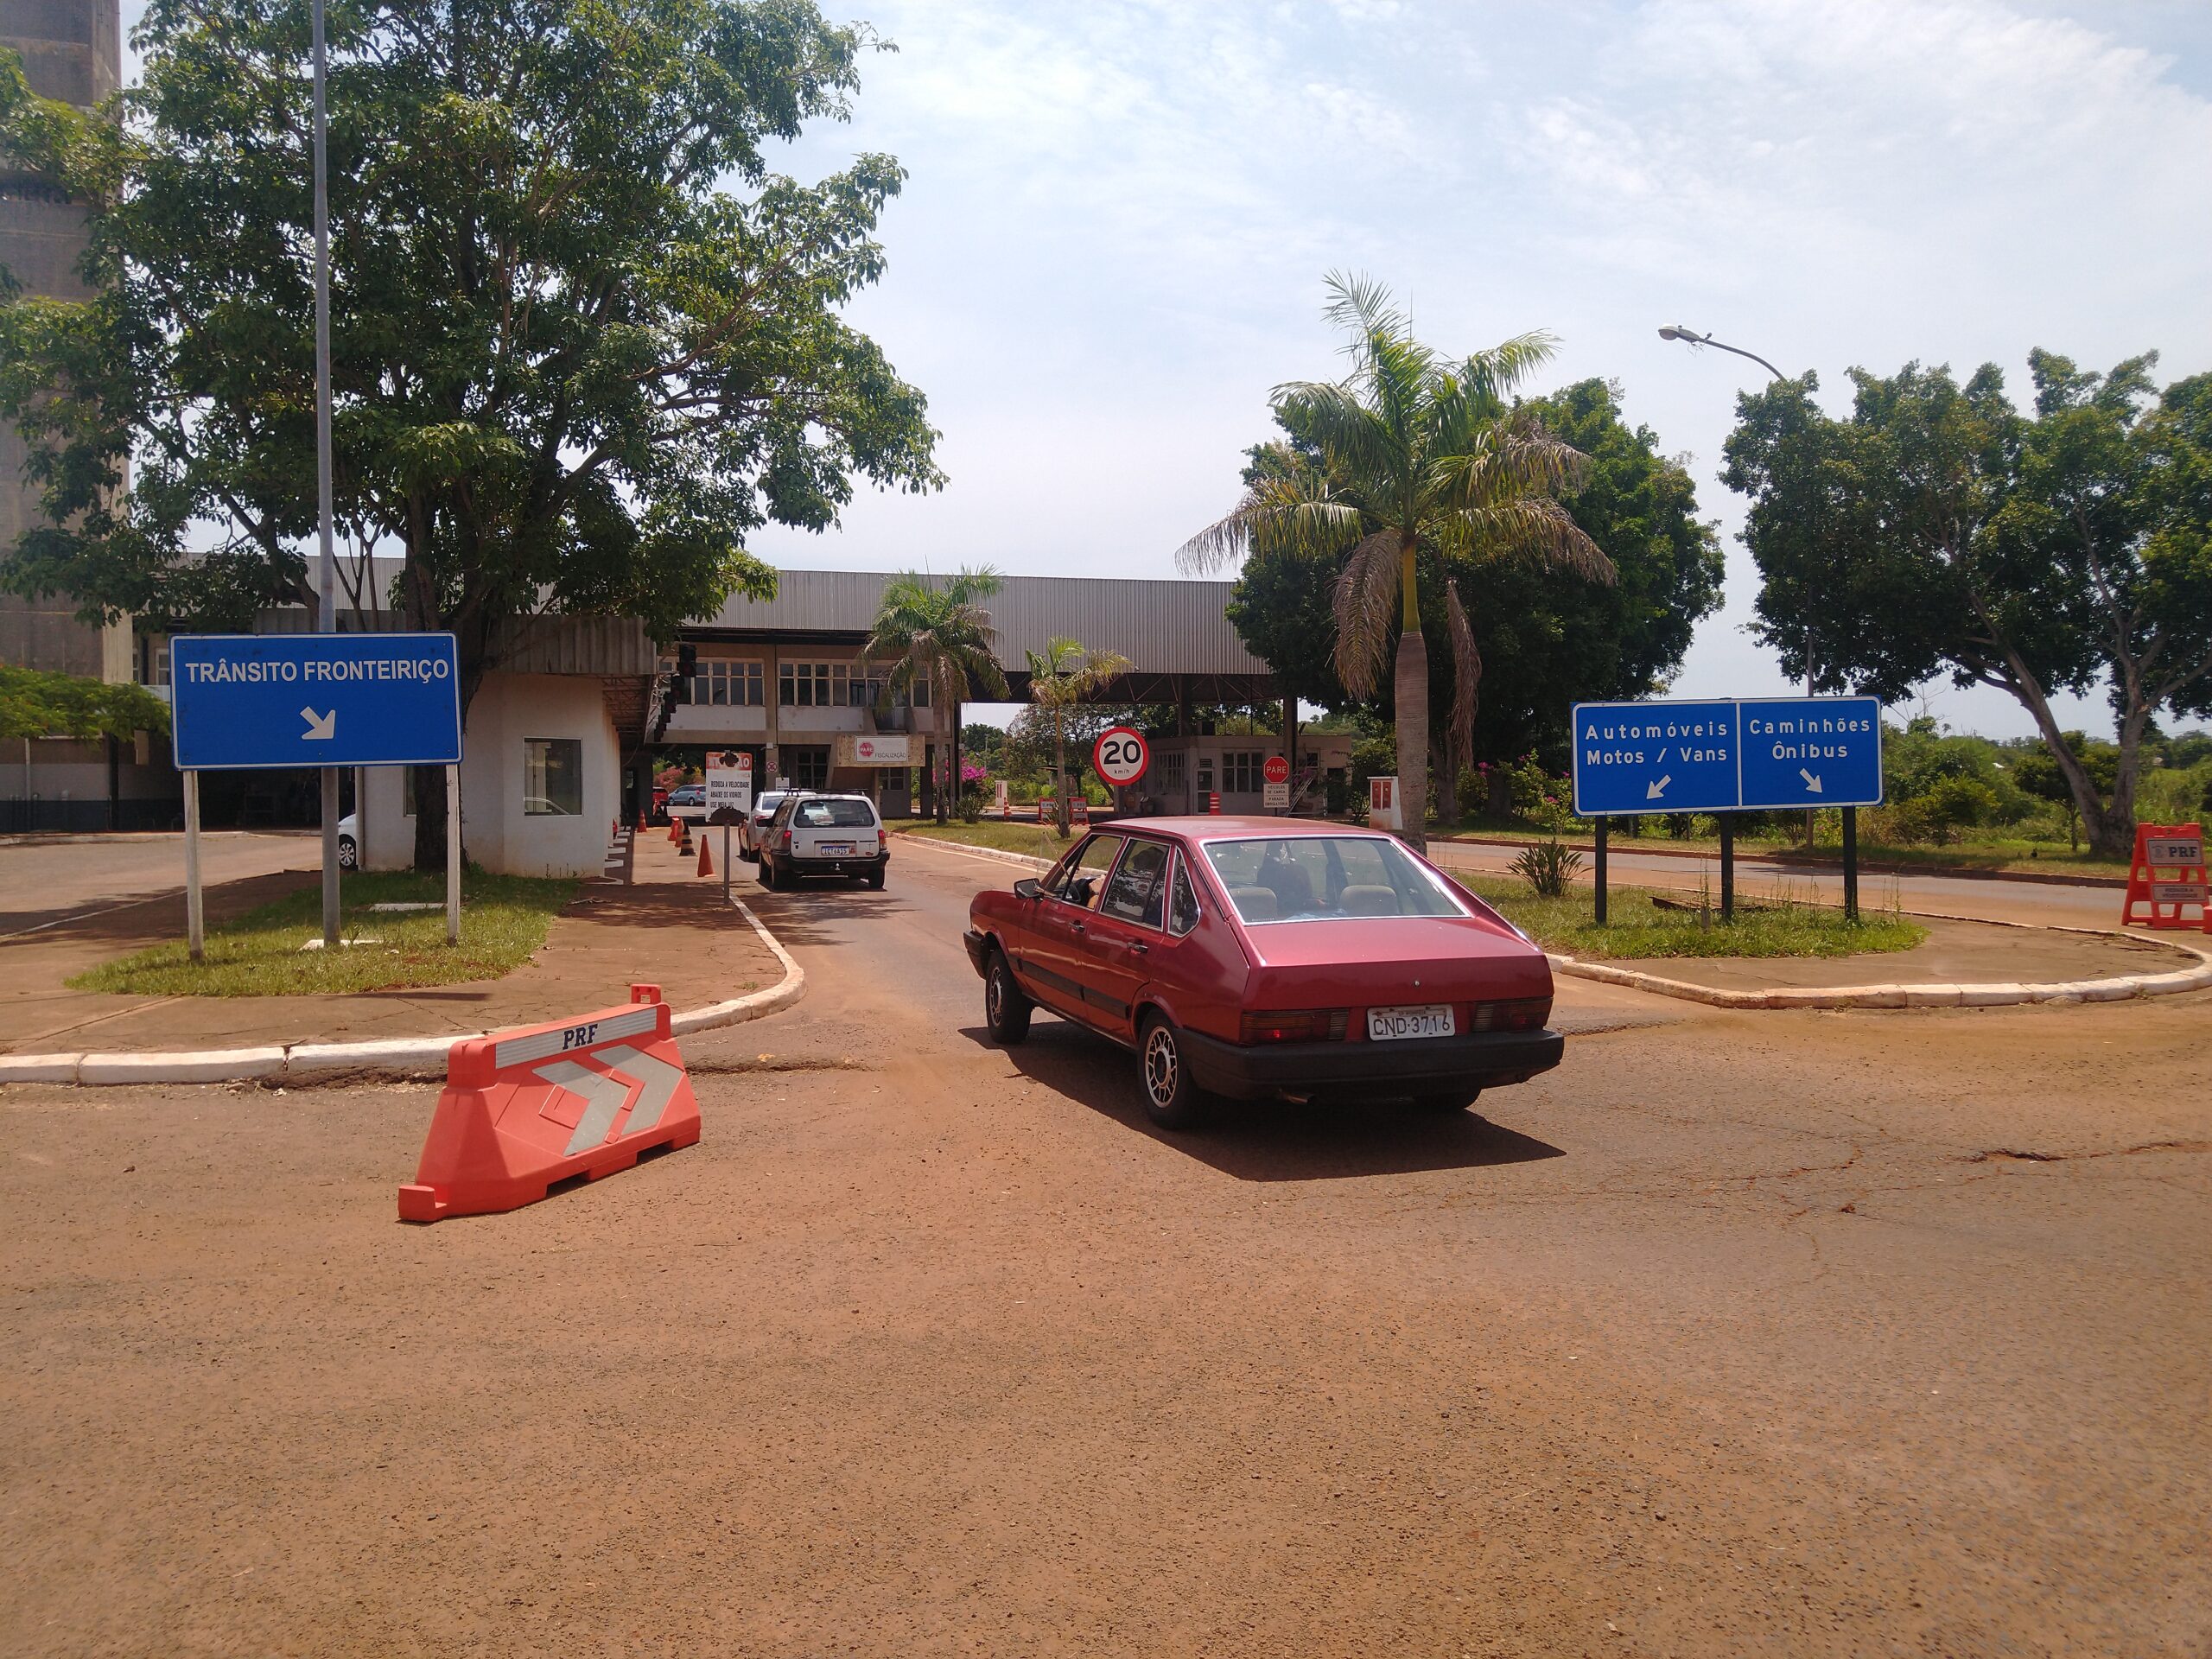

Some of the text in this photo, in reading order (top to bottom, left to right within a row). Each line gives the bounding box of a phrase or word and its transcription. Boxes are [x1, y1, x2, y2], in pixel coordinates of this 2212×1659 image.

[185, 658, 449, 684] TRÂNSITO FRONTEIRIÇO
[1585, 721, 1728, 741] Automóveis
[1749, 717, 1871, 734] Caminhões
[874, 751, 906, 760] FISCALIZAÇÃO
[1103, 740, 1141, 765] 20
[1586, 746, 1727, 766] Motos / Vans
[1772, 741, 1848, 760] Ônibus
[1266, 766, 1287, 774] PARE
[2168, 846, 2198, 858] PRF
[562, 1023, 599, 1051] PRF
